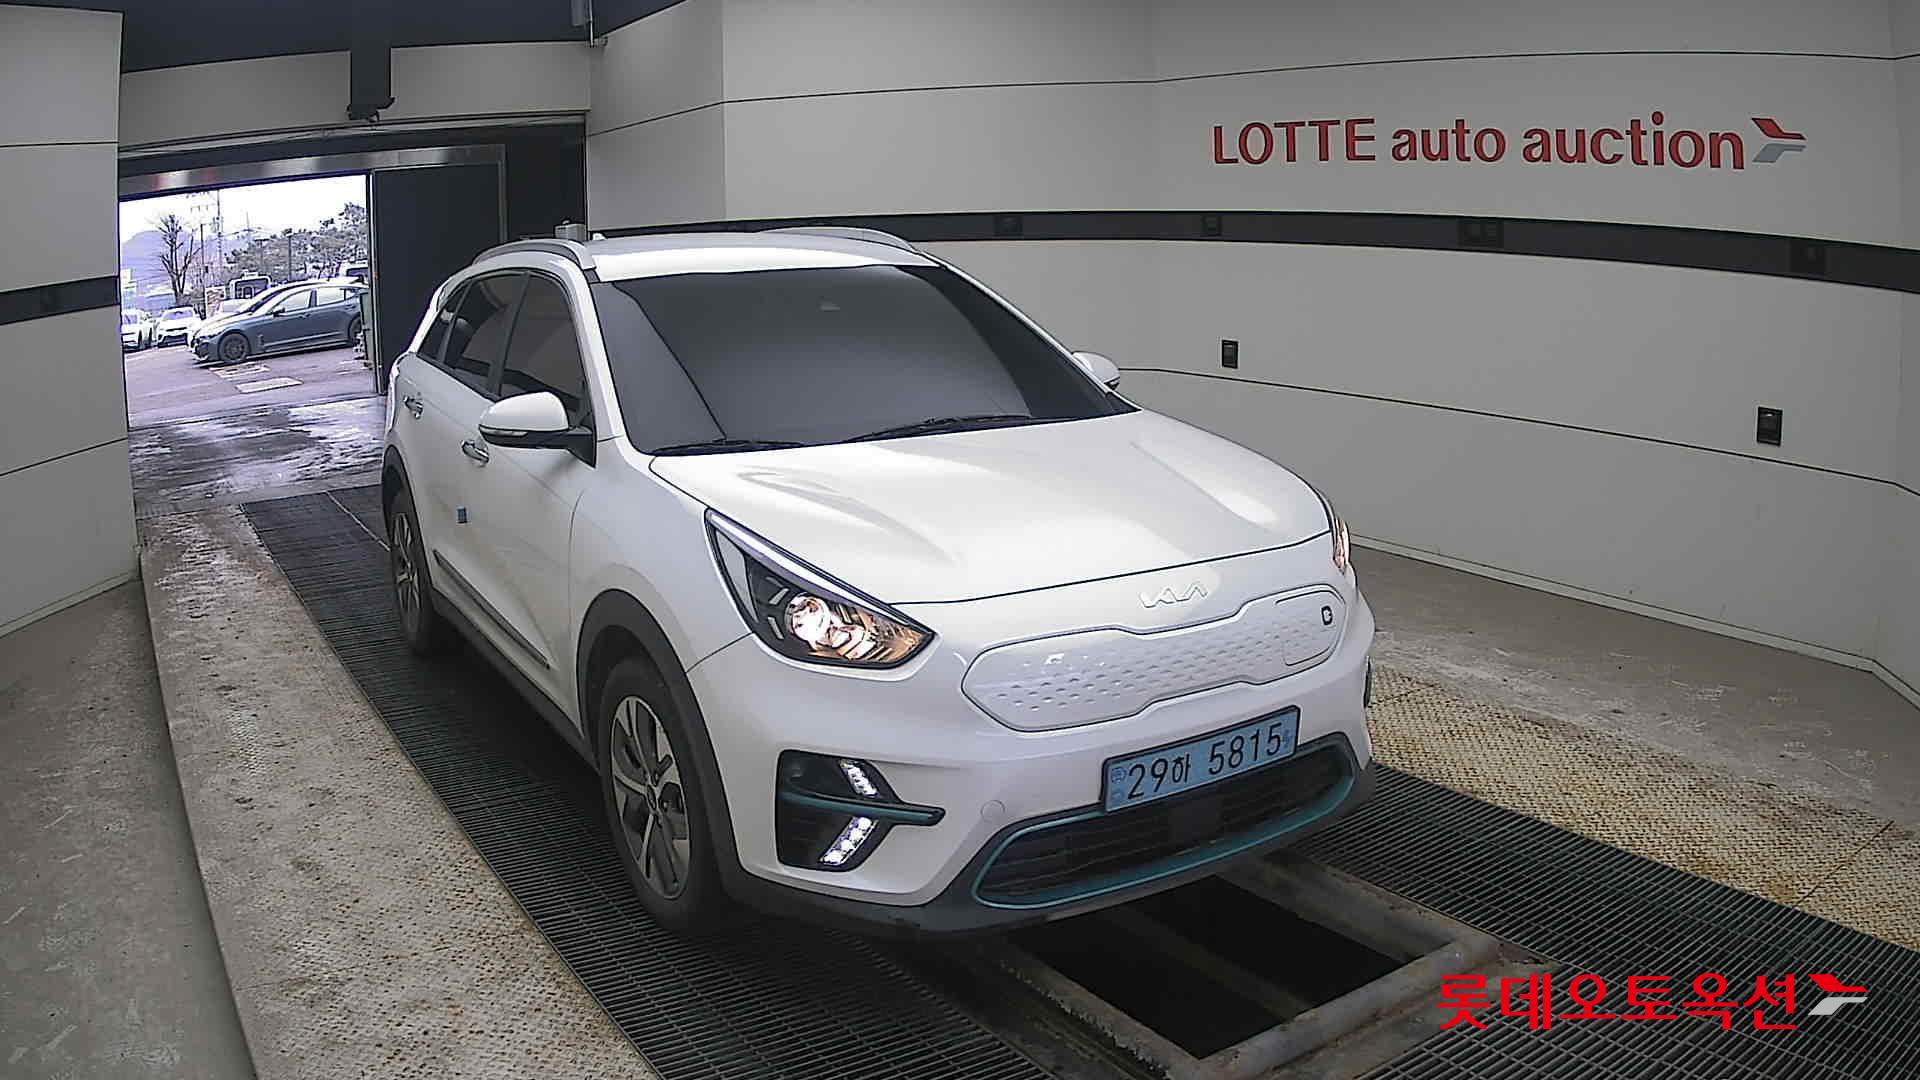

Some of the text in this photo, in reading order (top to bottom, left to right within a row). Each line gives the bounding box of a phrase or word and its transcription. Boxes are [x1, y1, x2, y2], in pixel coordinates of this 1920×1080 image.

[1213, 111, 1745, 170] LOTTE auto auction
[1127, 722, 1283, 800] 29하 5815
